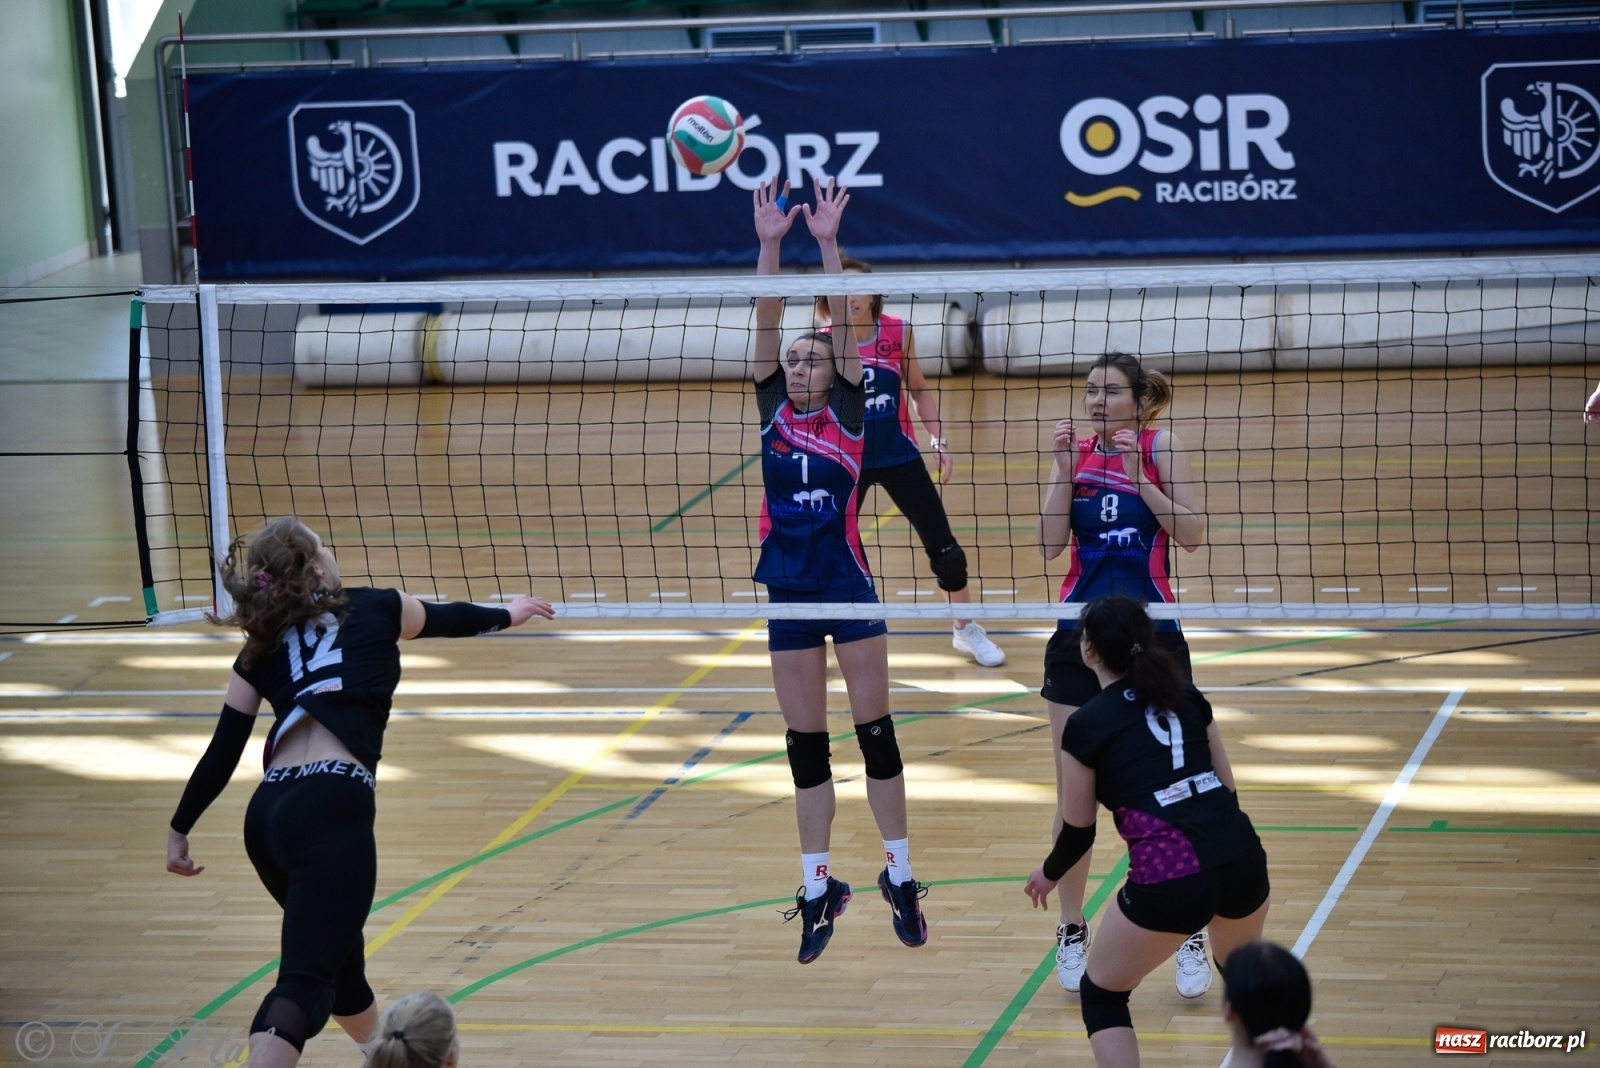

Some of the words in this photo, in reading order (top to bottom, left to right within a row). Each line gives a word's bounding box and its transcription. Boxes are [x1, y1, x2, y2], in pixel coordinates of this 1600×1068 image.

[687, 116, 715, 143] molten
[1060, 94, 1296, 175] OSiR
[1155, 173, 1298, 204] RACIBÓRZ
[791, 452, 809, 485] 7
[1100, 493, 1119, 523] 8
[282, 612, 343, 683] 12
[1144, 704, 1185, 771] 9
[295, 759, 351, 780] NIKE
[350, 763, 377, 791] PR
[815, 864, 828, 877] R
[886, 851, 896, 864] R
